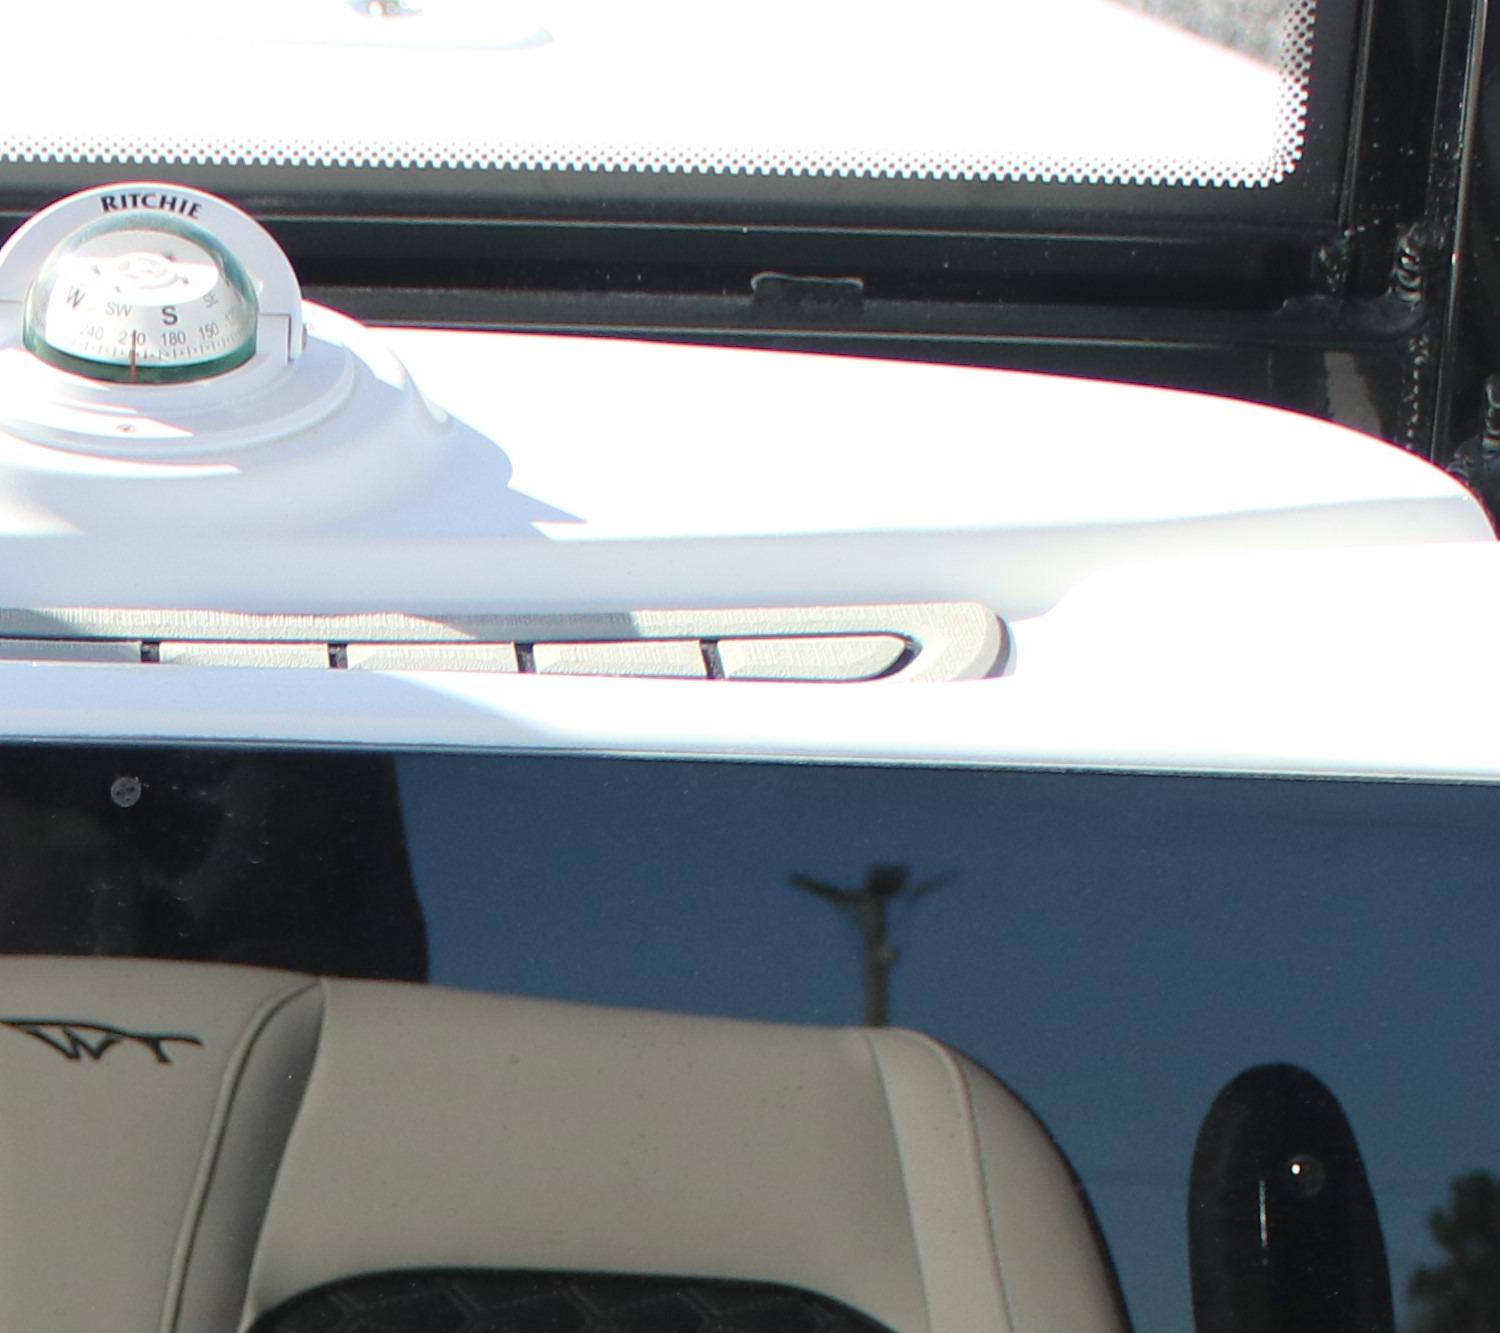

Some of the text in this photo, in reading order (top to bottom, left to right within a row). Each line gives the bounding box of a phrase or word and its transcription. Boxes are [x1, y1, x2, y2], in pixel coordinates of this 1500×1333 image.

[100, 192, 202, 218] RITCHIE
[105, 301, 133, 317] SW
[161, 305, 178, 325] S
[161, 331, 186, 346] 180
[199, 322, 219, 341] 150
